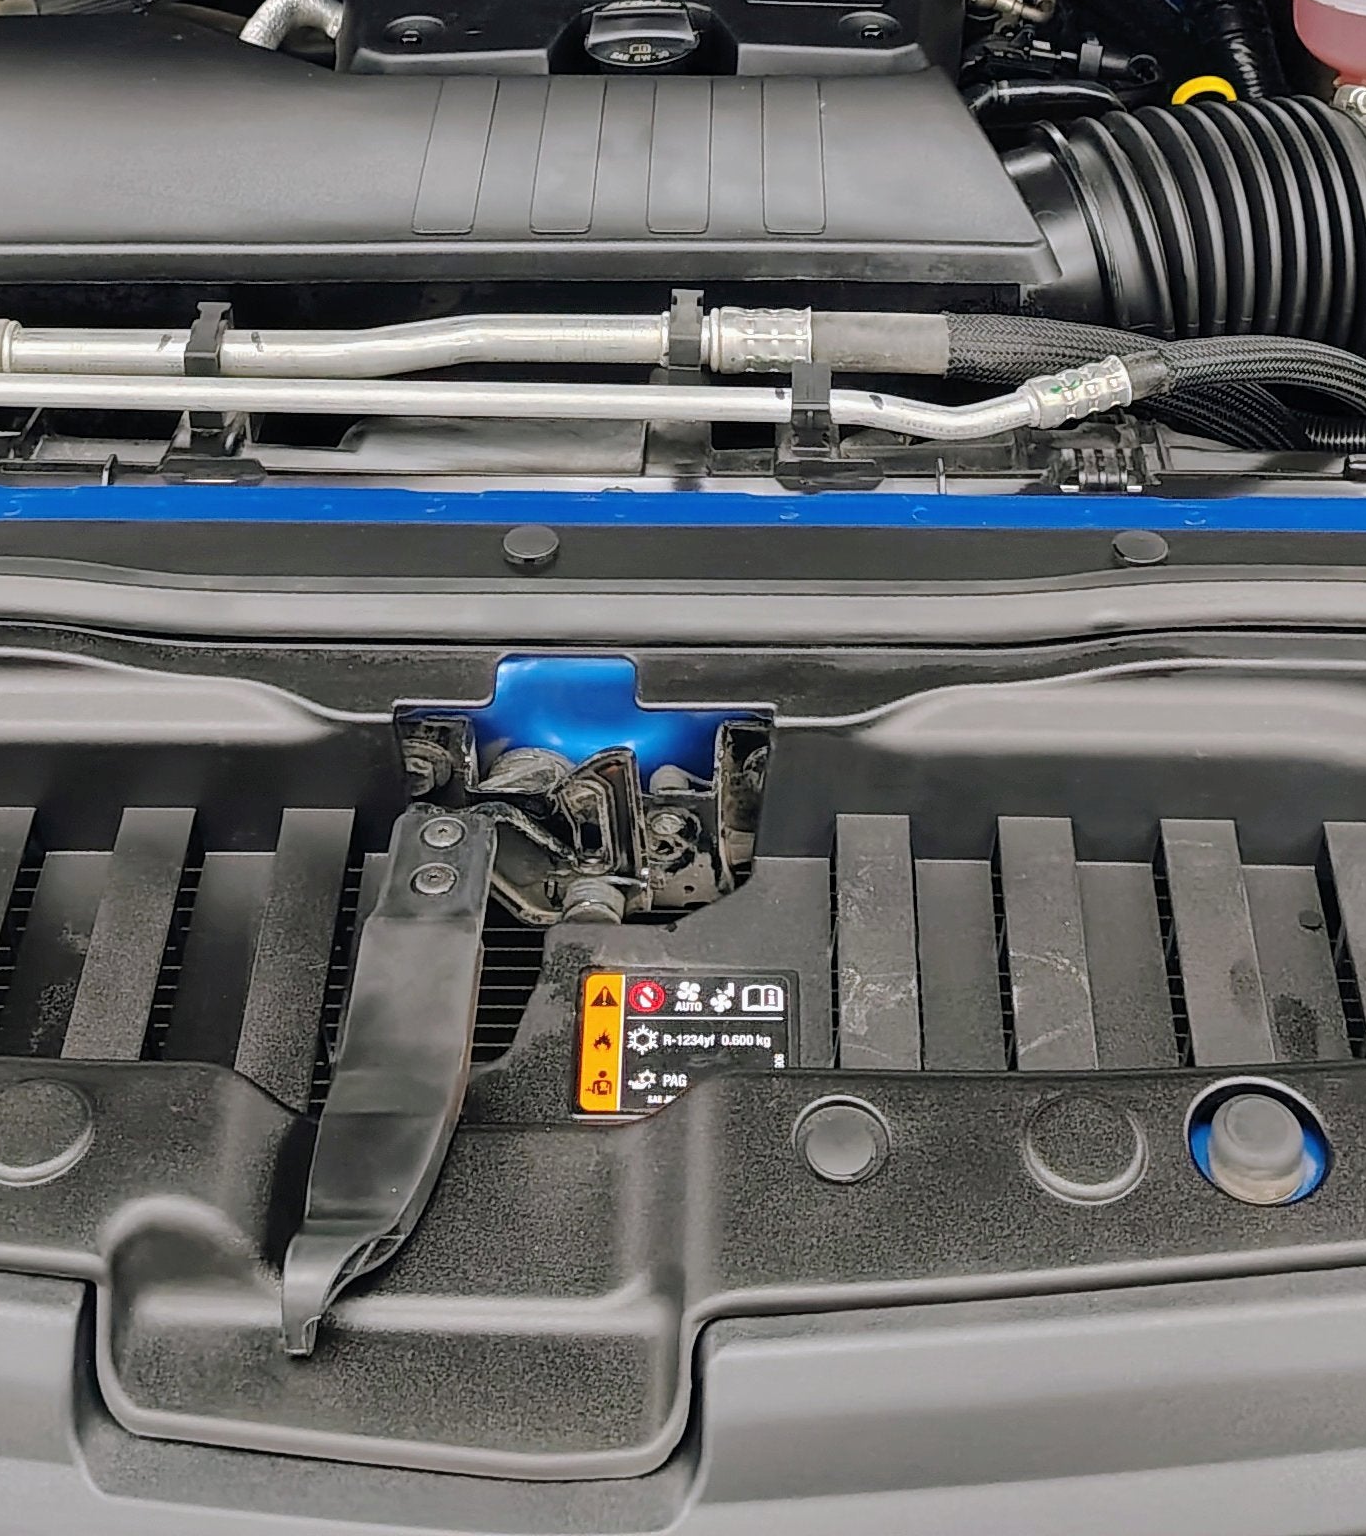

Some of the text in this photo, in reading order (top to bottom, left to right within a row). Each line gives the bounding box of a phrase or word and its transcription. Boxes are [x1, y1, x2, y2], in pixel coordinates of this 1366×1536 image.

[674, 1001, 703, 1012] AUTO
[662, 1033, 772, 1049] R-1234yf 0.600 kg
[662, 1073, 688, 1088] PAG
